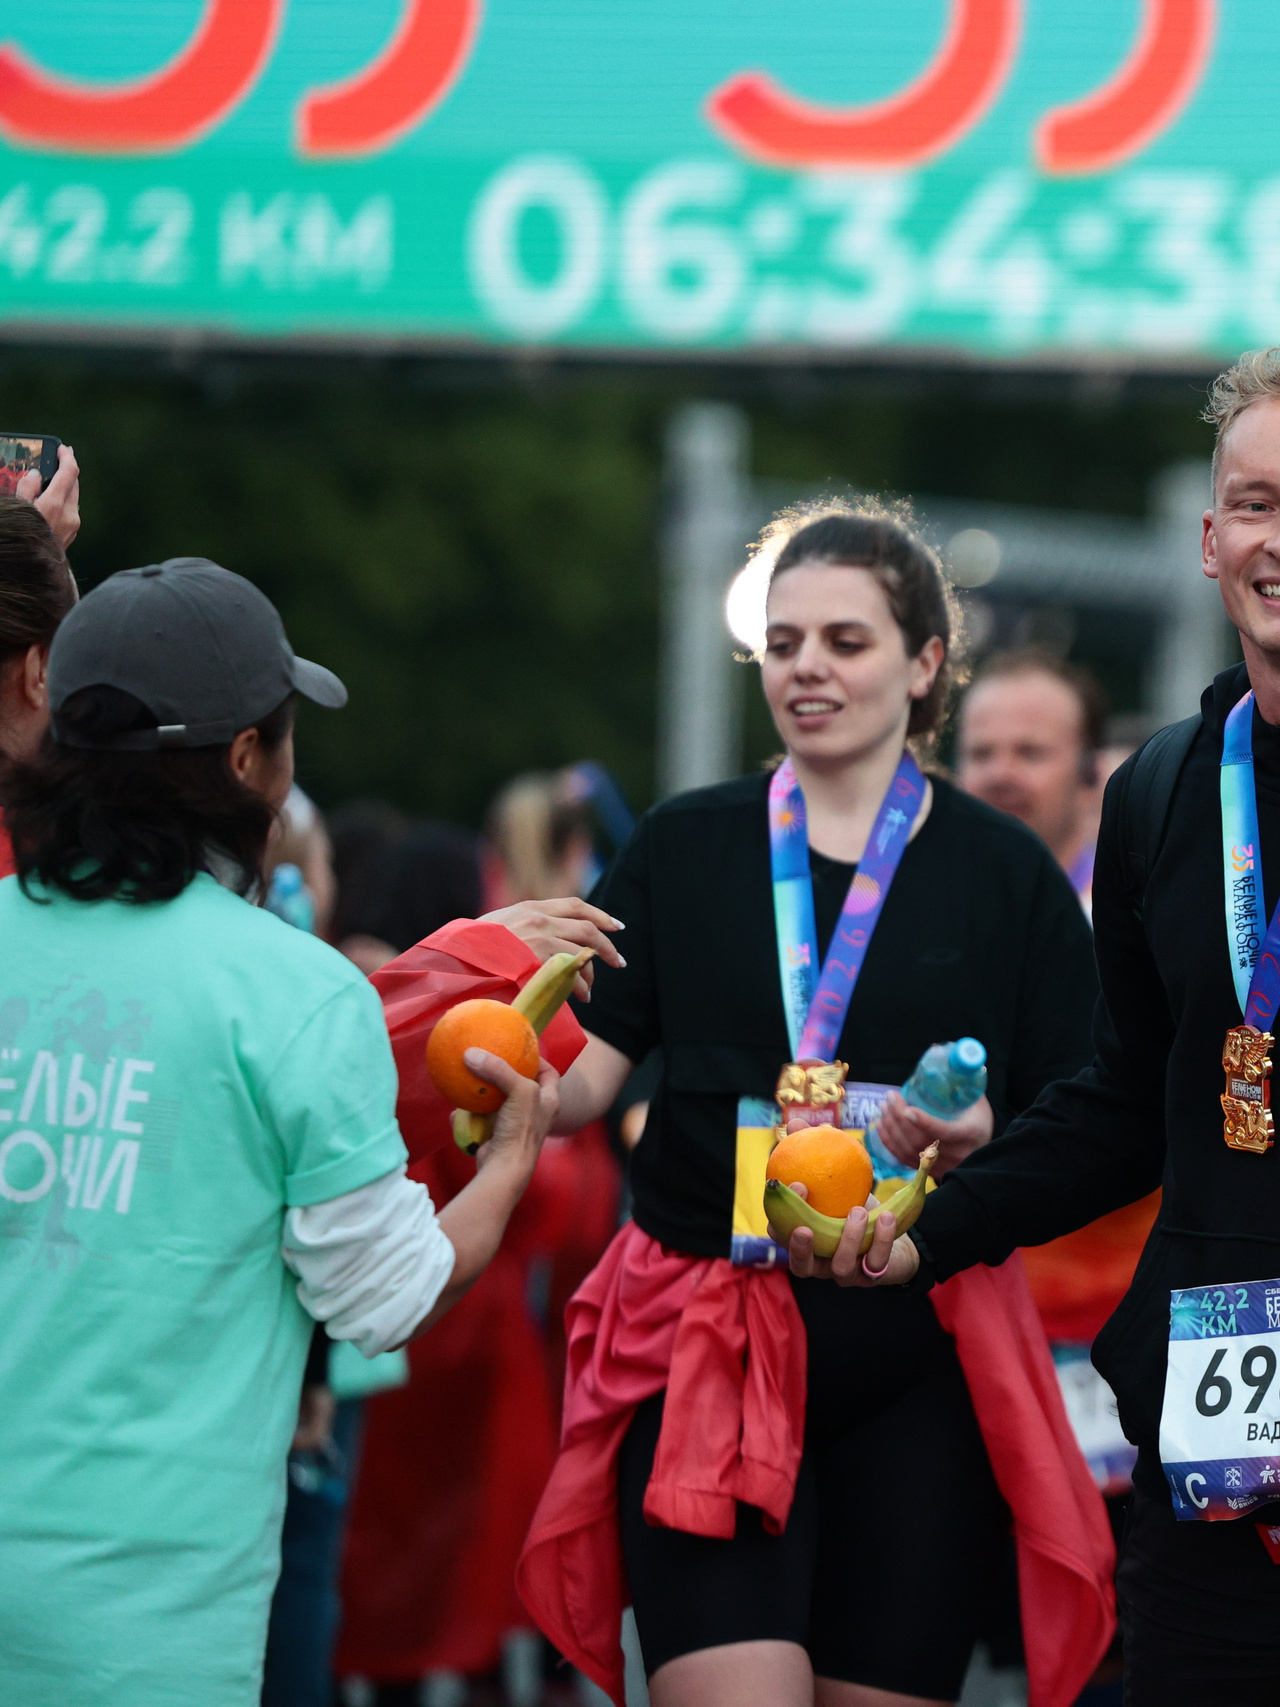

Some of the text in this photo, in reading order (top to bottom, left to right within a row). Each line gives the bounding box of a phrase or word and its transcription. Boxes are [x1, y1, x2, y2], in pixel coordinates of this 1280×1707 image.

[1233, 879, 1249, 956] МАРАФОН
[1200, 1288, 1250, 1315] 42,2
[1201, 1313, 1238, 1337] КМ
